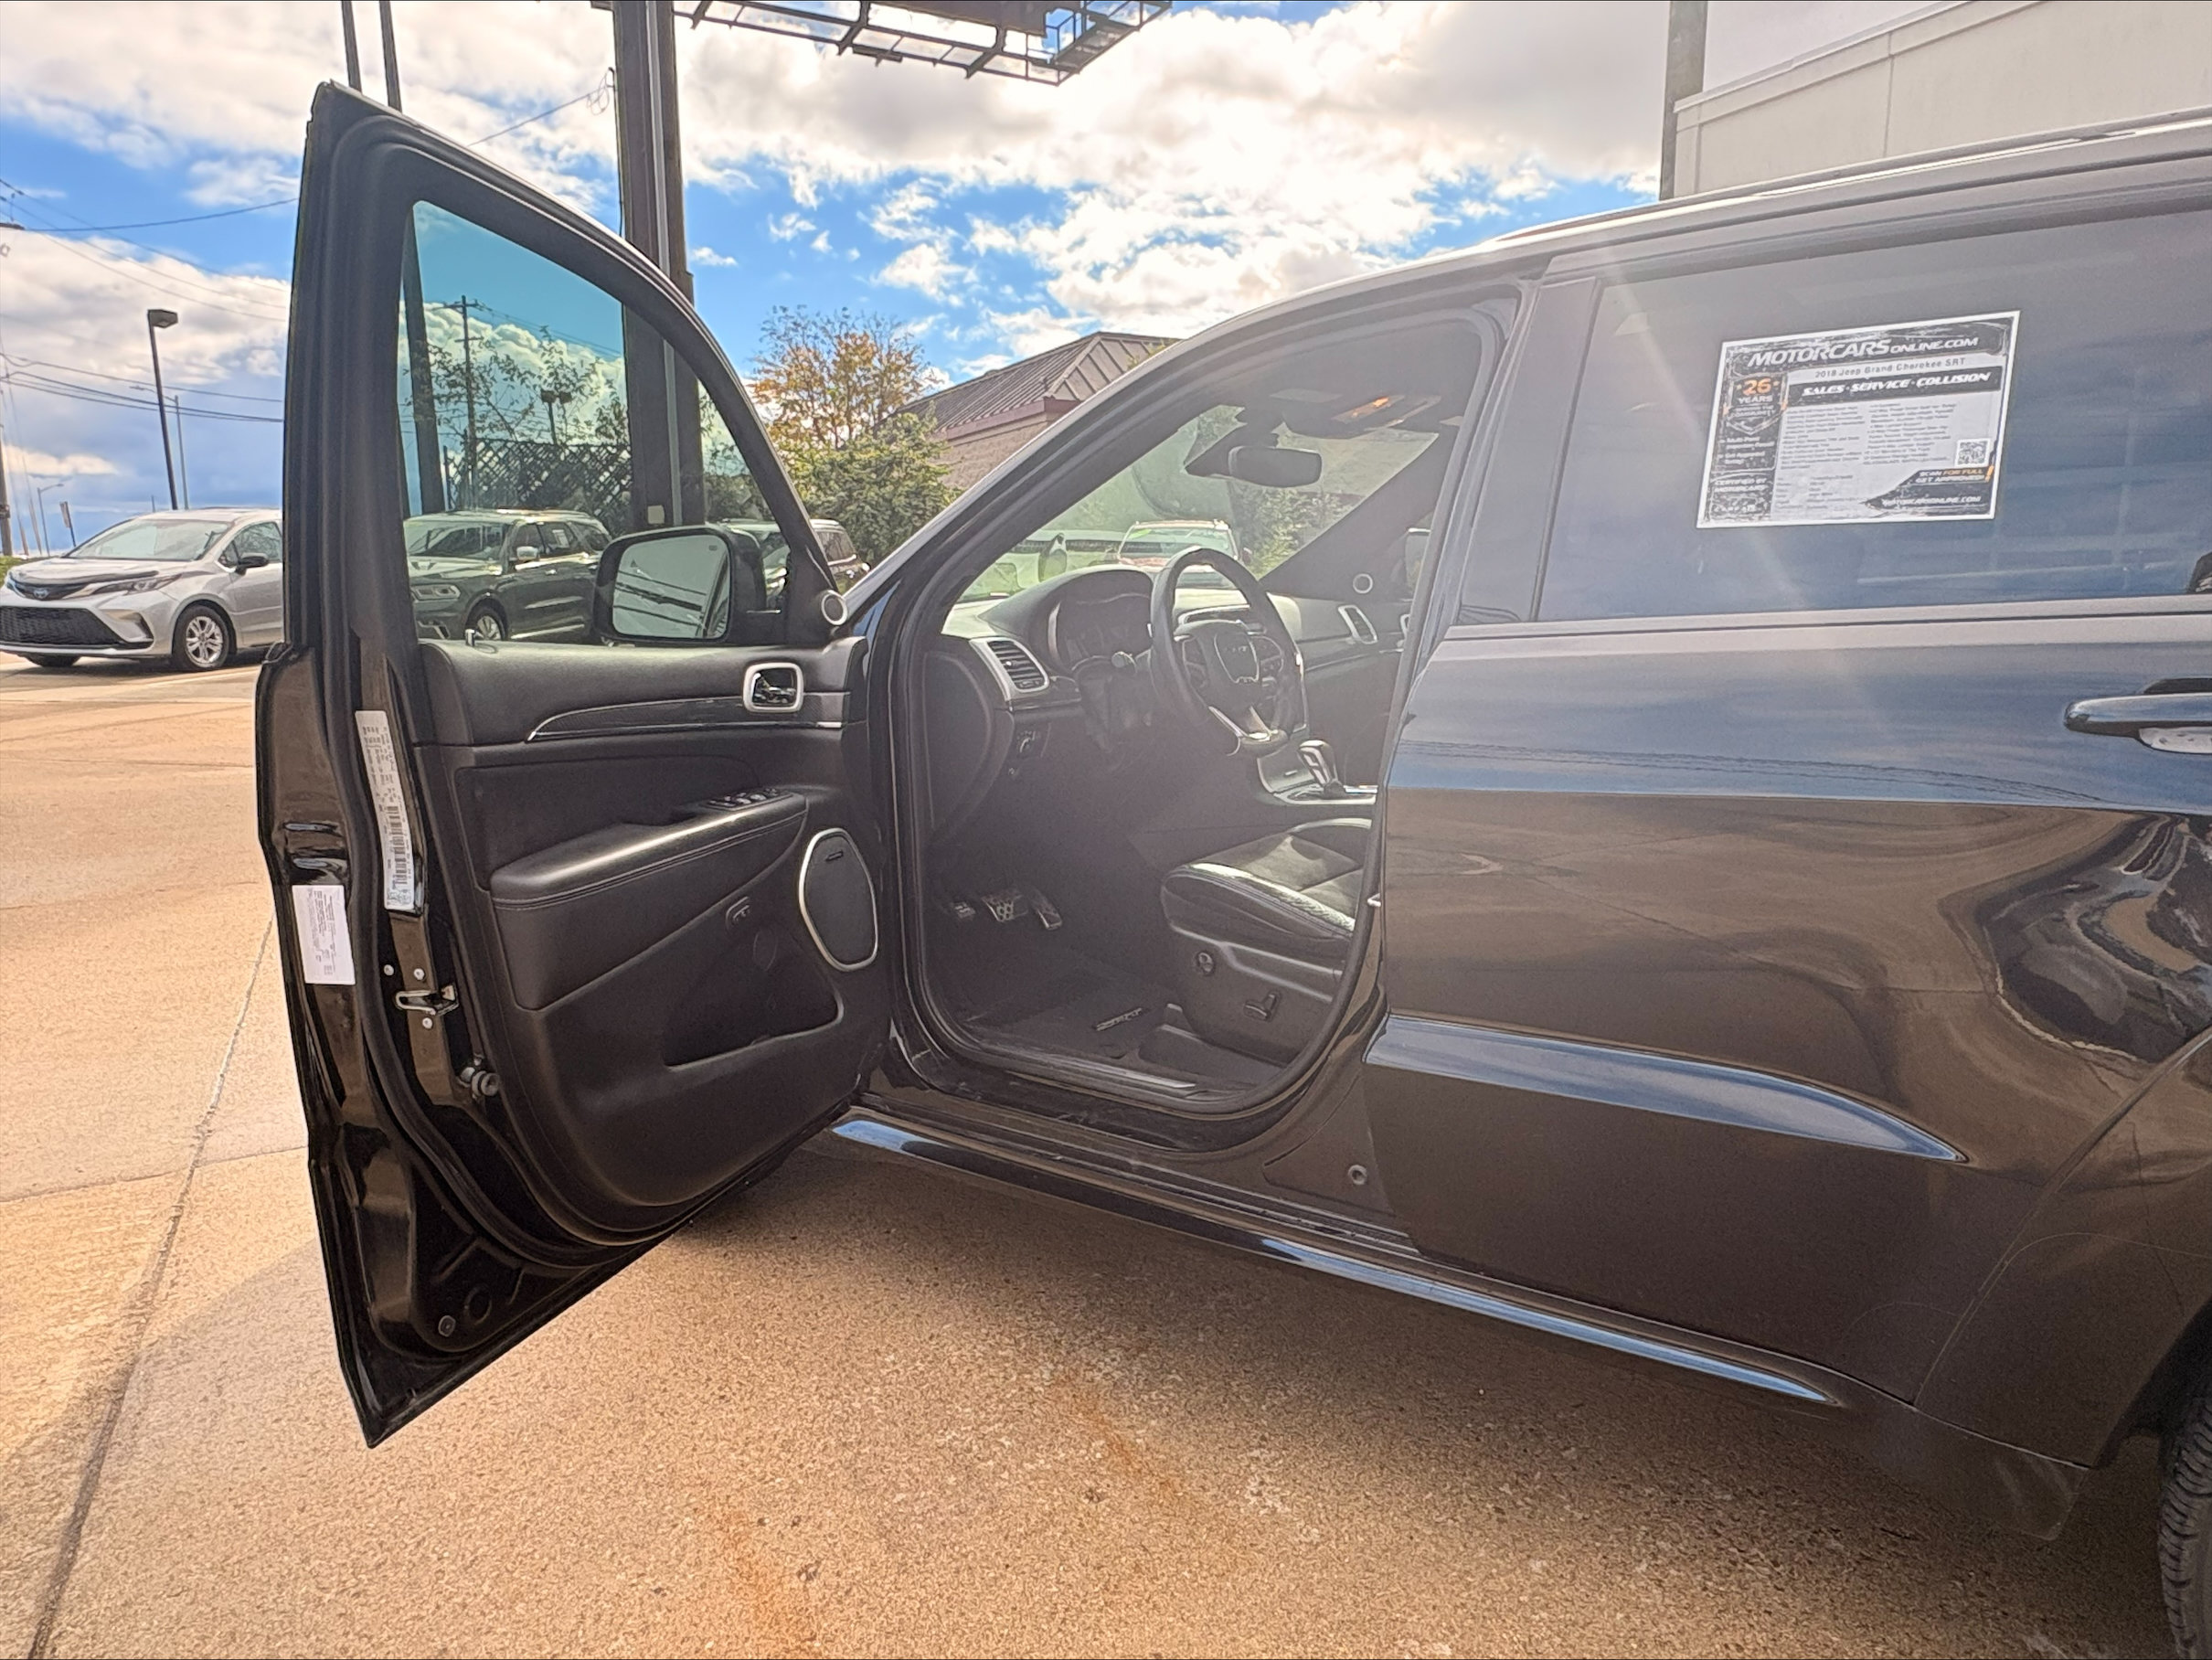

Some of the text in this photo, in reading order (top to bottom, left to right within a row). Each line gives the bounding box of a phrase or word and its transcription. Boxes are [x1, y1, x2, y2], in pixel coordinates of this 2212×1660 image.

[1814, 357, 1966, 378] 2018 Jeep Grand Cherokee SRT
[1742, 378, 1771, 396] 26
[1802, 372, 1992, 397] SALES SERVICE COLLISION
[1738, 395, 1773, 404] YEARS
